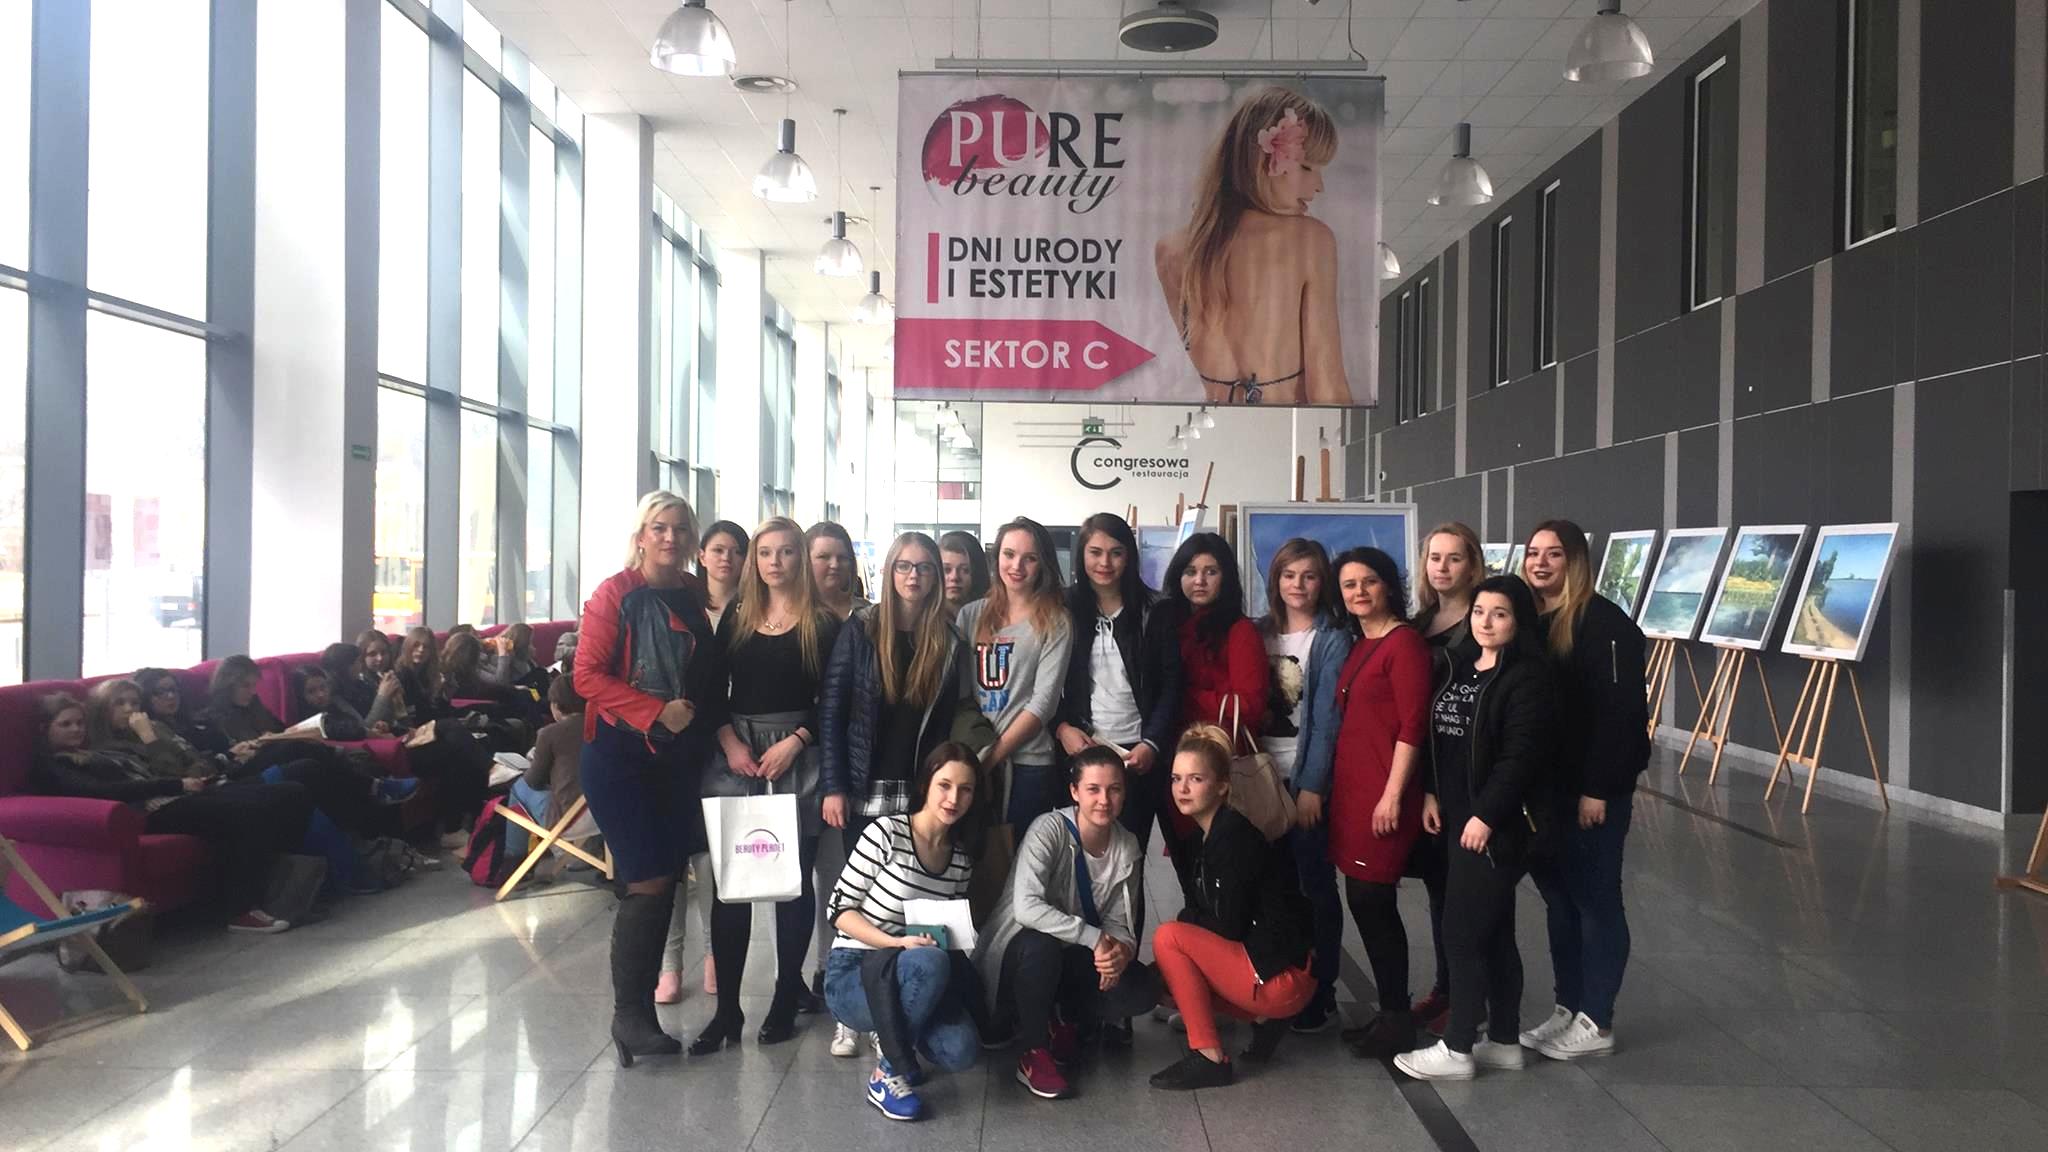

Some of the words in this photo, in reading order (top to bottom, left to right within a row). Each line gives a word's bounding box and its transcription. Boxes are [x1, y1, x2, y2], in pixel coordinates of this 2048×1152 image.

[949, 111, 1126, 169] PURE
[952, 155, 1124, 214] beauty
[948, 237, 1002, 263] DNI
[1014, 238, 1123, 264] URODY
[948, 269, 955, 297] I
[970, 269, 1117, 299] ESTETYKI
[944, 340, 1071, 369] SEKTOR
[1083, 341, 1110, 369] C
[1093, 457, 1189, 471] congresowa
[1132, 471, 1189, 479] restauracja
